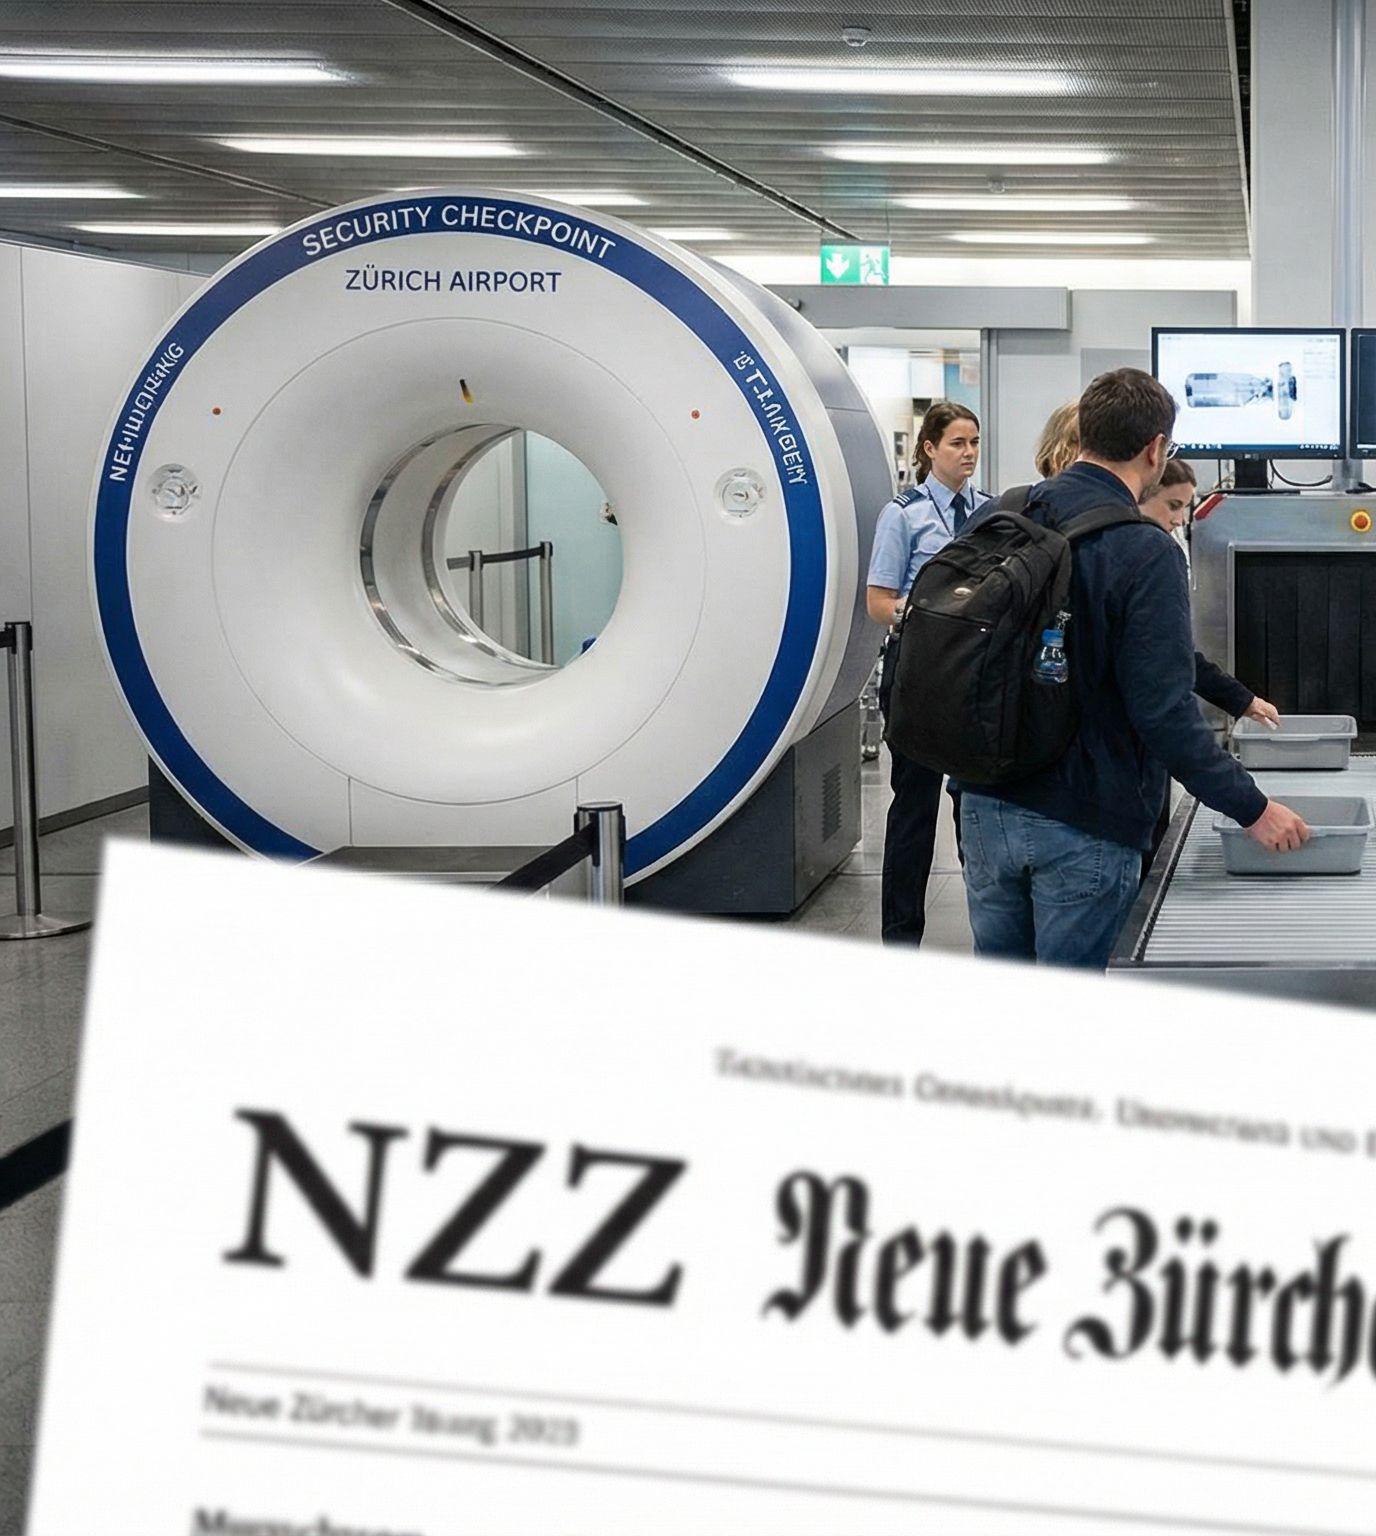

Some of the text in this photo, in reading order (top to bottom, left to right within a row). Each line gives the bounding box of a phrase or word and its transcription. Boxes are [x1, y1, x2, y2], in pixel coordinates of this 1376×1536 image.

[302, 203, 617, 260] SECURITY CHECKPOINT
[345, 263, 562, 293] ZÜRICH AIRPORT
[223, 1108, 688, 1308] NZZ
[762, 1168, 1048, 1348] Neue
